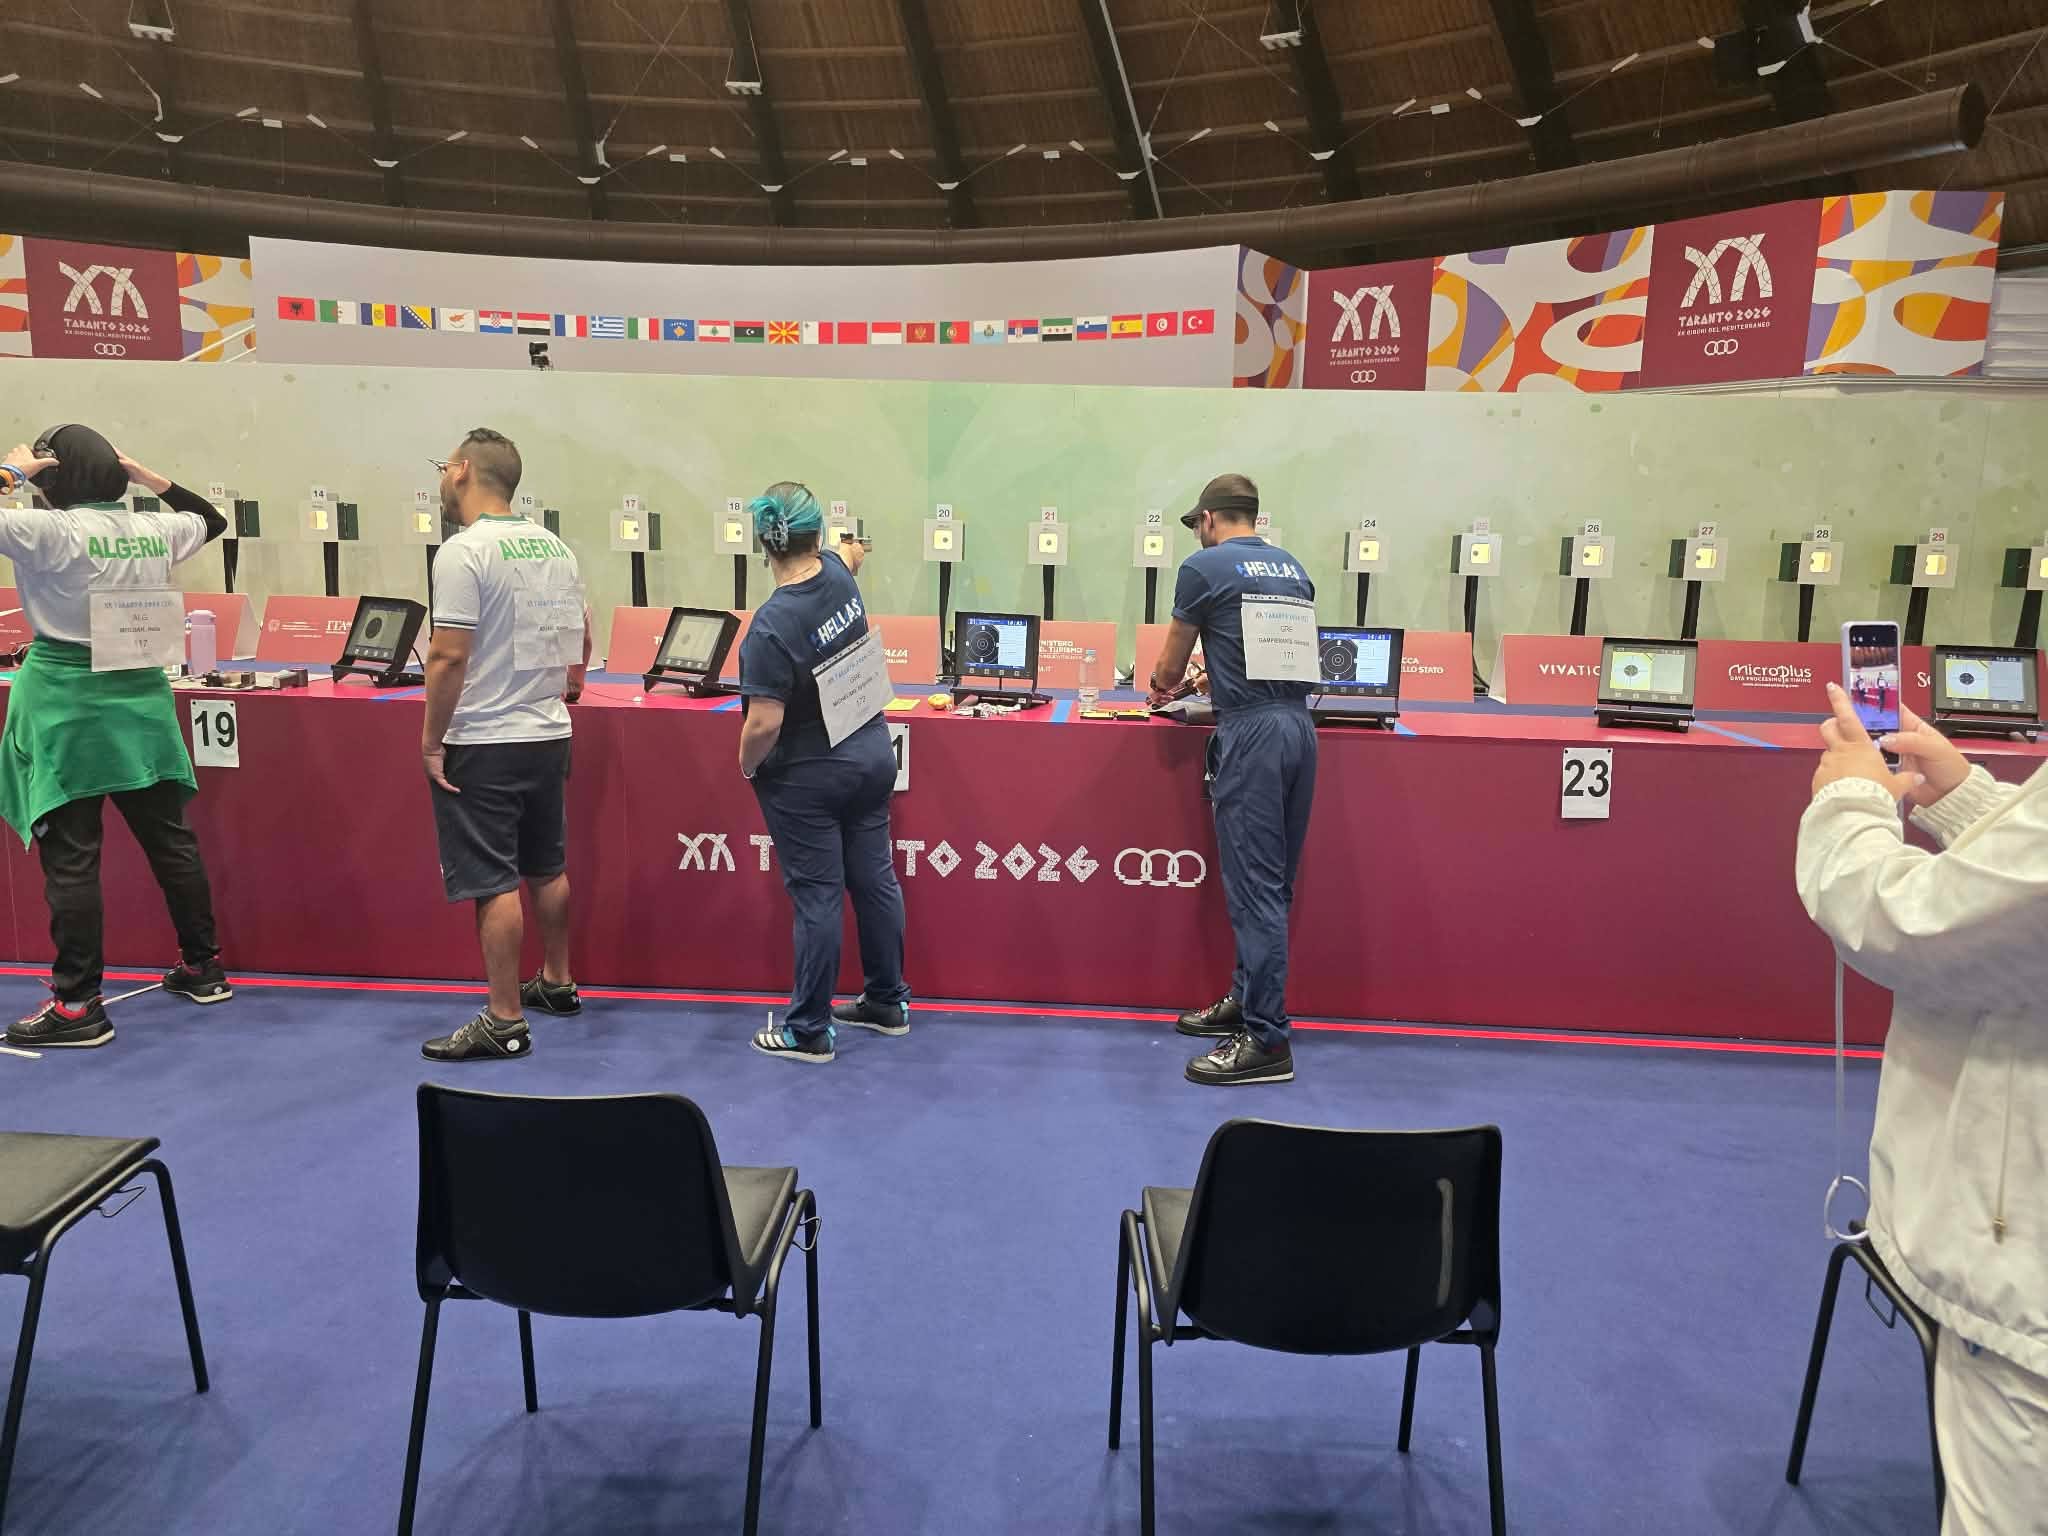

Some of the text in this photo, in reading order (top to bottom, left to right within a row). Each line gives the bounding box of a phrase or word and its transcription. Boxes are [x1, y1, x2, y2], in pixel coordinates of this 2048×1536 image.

[1680, 233, 1772, 308] XX
[59, 261, 149, 319] XX
[1331, 284, 1400, 342] XX
[1679, 306, 1772, 327] TARANTO 2026
[63, 318, 150, 333] TARANTO 2026
[1330, 344, 1400, 359] TARANTO 2026
[212, 488, 222, 496] 13
[314, 490, 324, 498] 14
[417, 492, 427, 500] 15
[625, 500, 636, 508] 17
[729, 502, 740, 510] 18
[834, 505, 844, 514] 19
[939, 509, 950, 518] 20
[1044, 512, 1055, 521] 21
[1148, 514, 1160, 523] 22
[1256, 517, 1268, 526] 23
[1364, 519, 1376, 528] 24
[1587, 524, 1599, 533] 26
[1702, 526, 1714, 535] 27
[1816, 529, 1829, 538] 28
[1932, 533, 1945, 541] 29
[88, 536, 169, 560] ALGERIA
[498, 537, 570, 560] ALGERIA
[1244, 561, 1300, 580] HELLAS
[817, 597, 862, 645] HELLAS
[1418, 666, 1444, 674] STATO
[194, 710, 236, 748] 19
[892, 734, 904, 771] 1
[1563, 759, 1610, 798] 23
[677, 832, 736, 872] XX
[974, 839, 1100, 883] 2026
